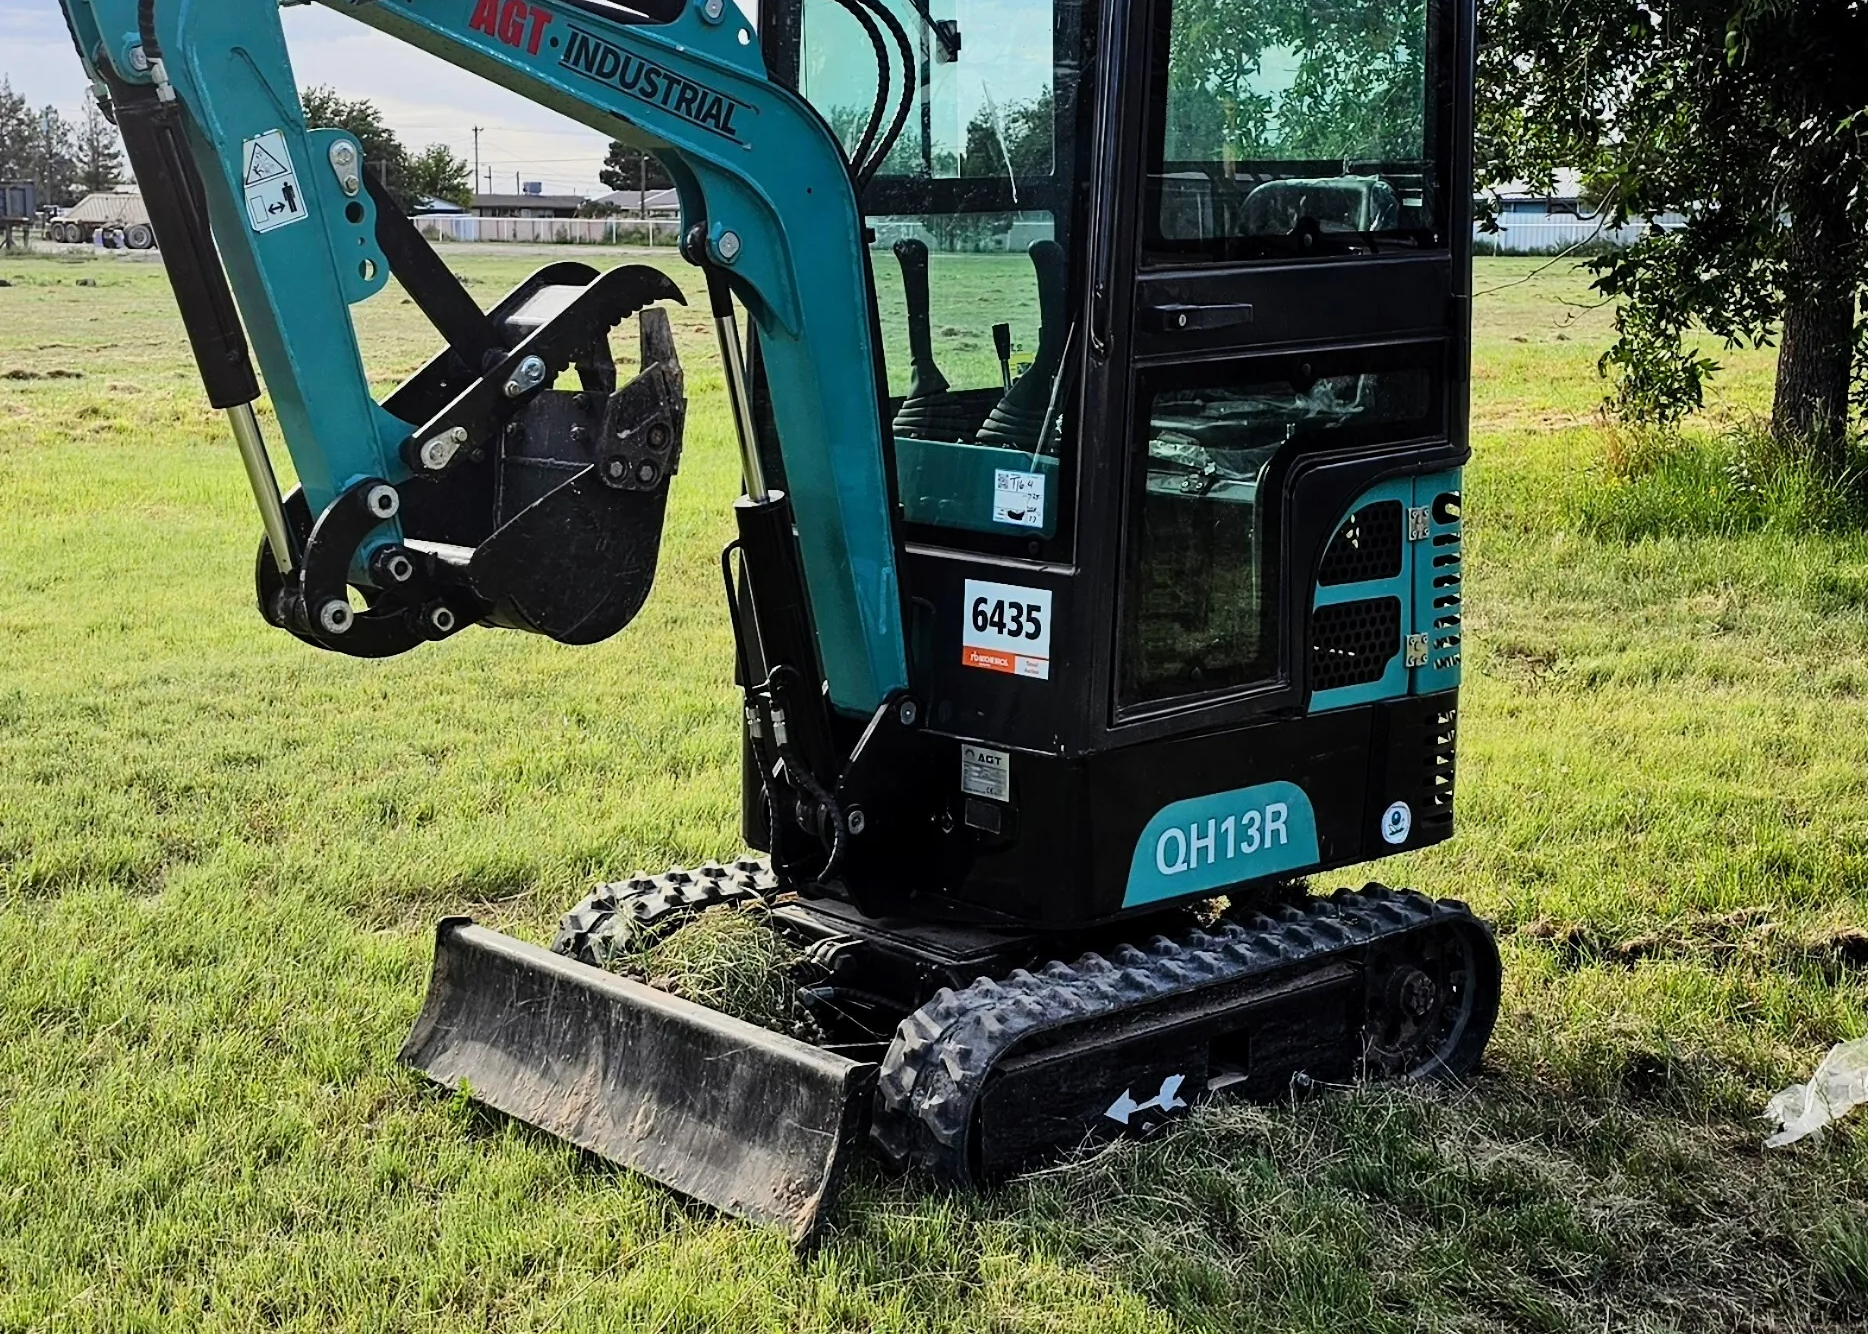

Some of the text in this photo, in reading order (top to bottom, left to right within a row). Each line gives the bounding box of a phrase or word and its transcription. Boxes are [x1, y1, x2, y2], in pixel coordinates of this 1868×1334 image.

[562, 32, 736, 136] INDUSTRIAL
[972, 596, 1042, 641] 6435
[977, 753, 1002, 766] AGT
[1156, 802, 1288, 875] QH13R
